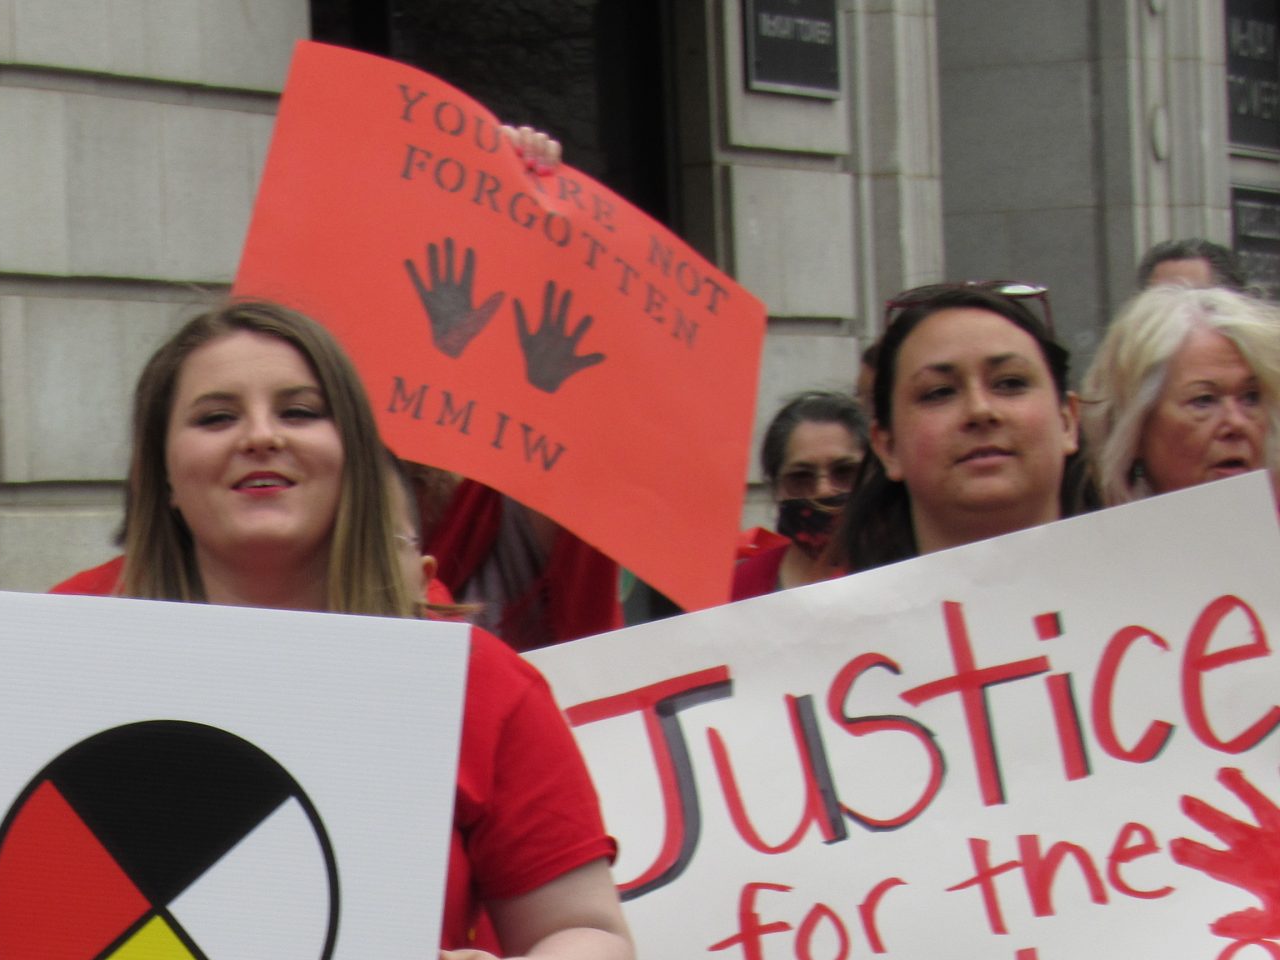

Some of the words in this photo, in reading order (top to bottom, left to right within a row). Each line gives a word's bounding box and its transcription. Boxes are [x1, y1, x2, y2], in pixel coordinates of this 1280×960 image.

[399, 84, 502, 153] YOU
[647, 236, 730, 316] NOT
[400, 144, 700, 347] FORGOTTEN
[386, 376, 567, 473] MMIW
[946, 821, 1176, 935] the
